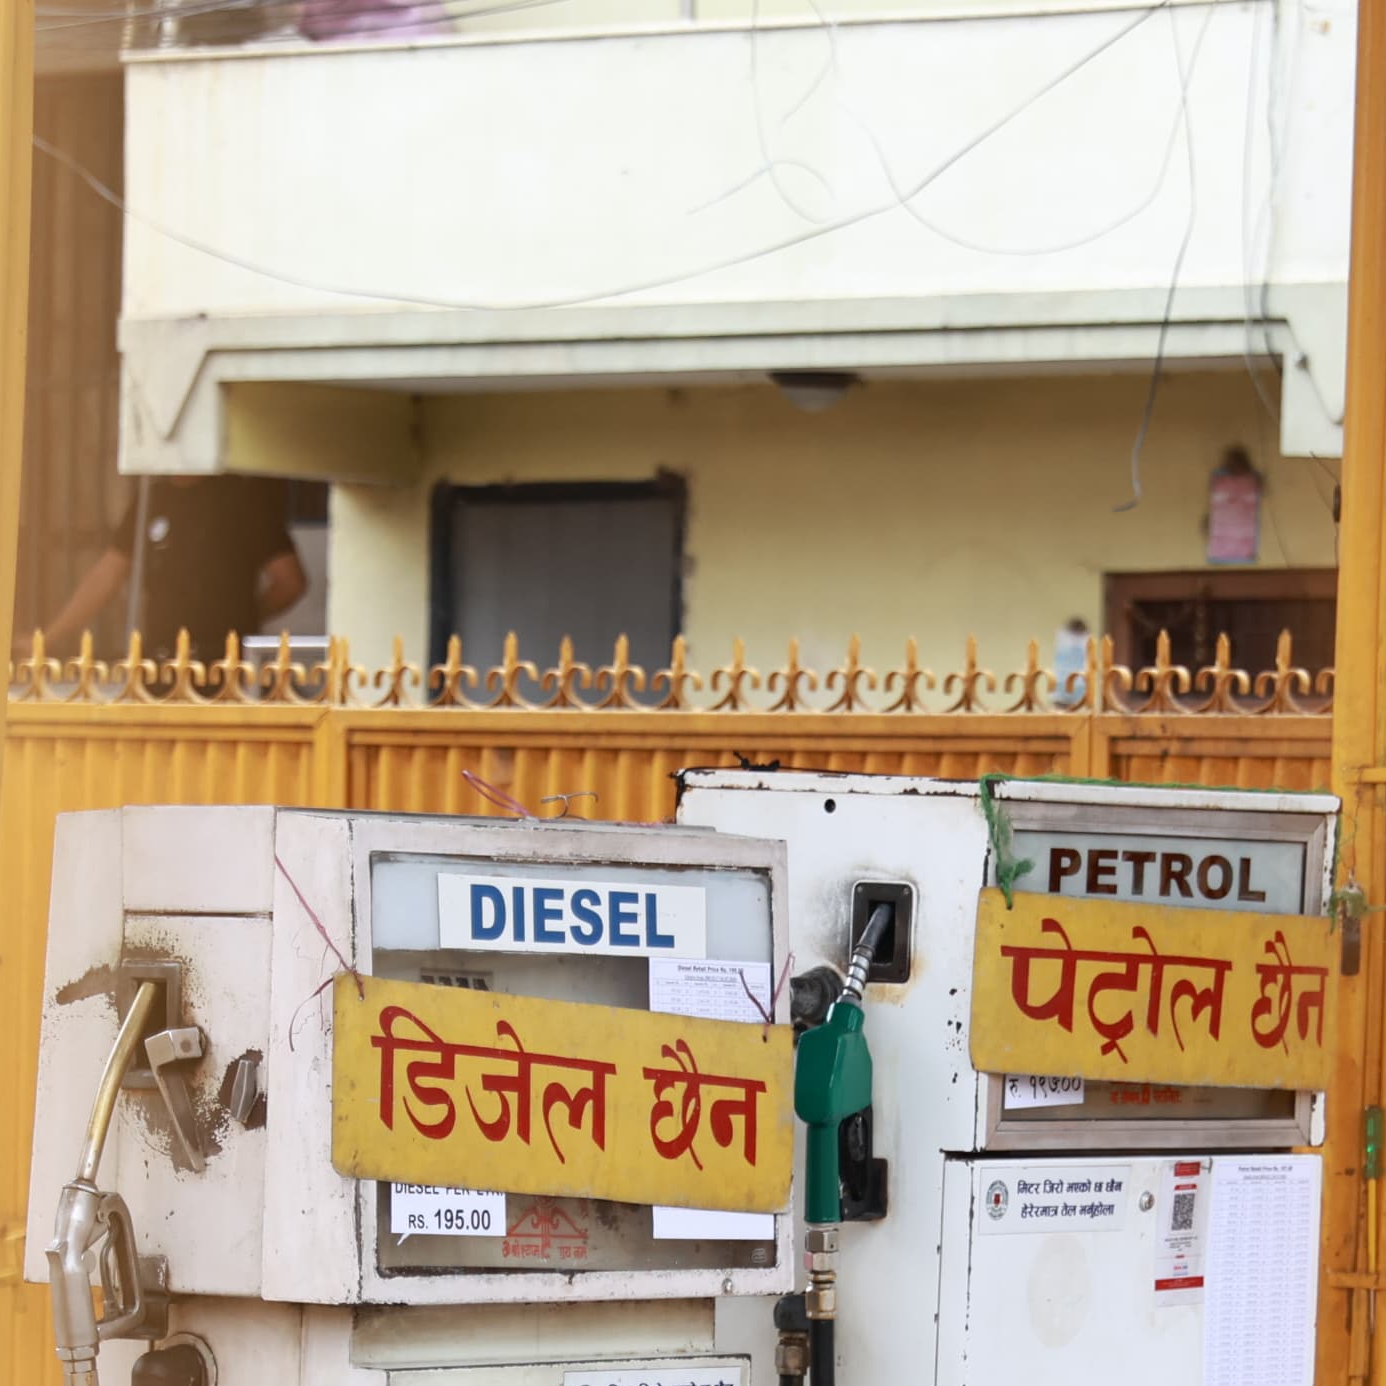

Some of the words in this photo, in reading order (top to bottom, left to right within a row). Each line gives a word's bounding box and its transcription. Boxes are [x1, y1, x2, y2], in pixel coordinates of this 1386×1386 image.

[1048, 847, 1267, 903] PETROL
[470, 884, 675, 948] DIESEL
[1000, 917, 1232, 1064] पेट्रोल
[1250, 931, 1329, 1055] छैन
[370, 1005, 617, 1165] डिजेल
[642, 1039, 767, 1171] छैन
[1017, 1179, 1040, 1195] मिटर
[1043, 1179, 1064, 1195] जिरो
[1066, 1179, 1092, 1194] भएको
[1094, 1181, 1103, 1193] छ
[1105, 1178, 1123, 1193] छैन
[1061, 1202, 1077, 1217] तेल
[408, 1214, 429, 1229] RS.
[434, 1208, 491, 1230] 195.00
